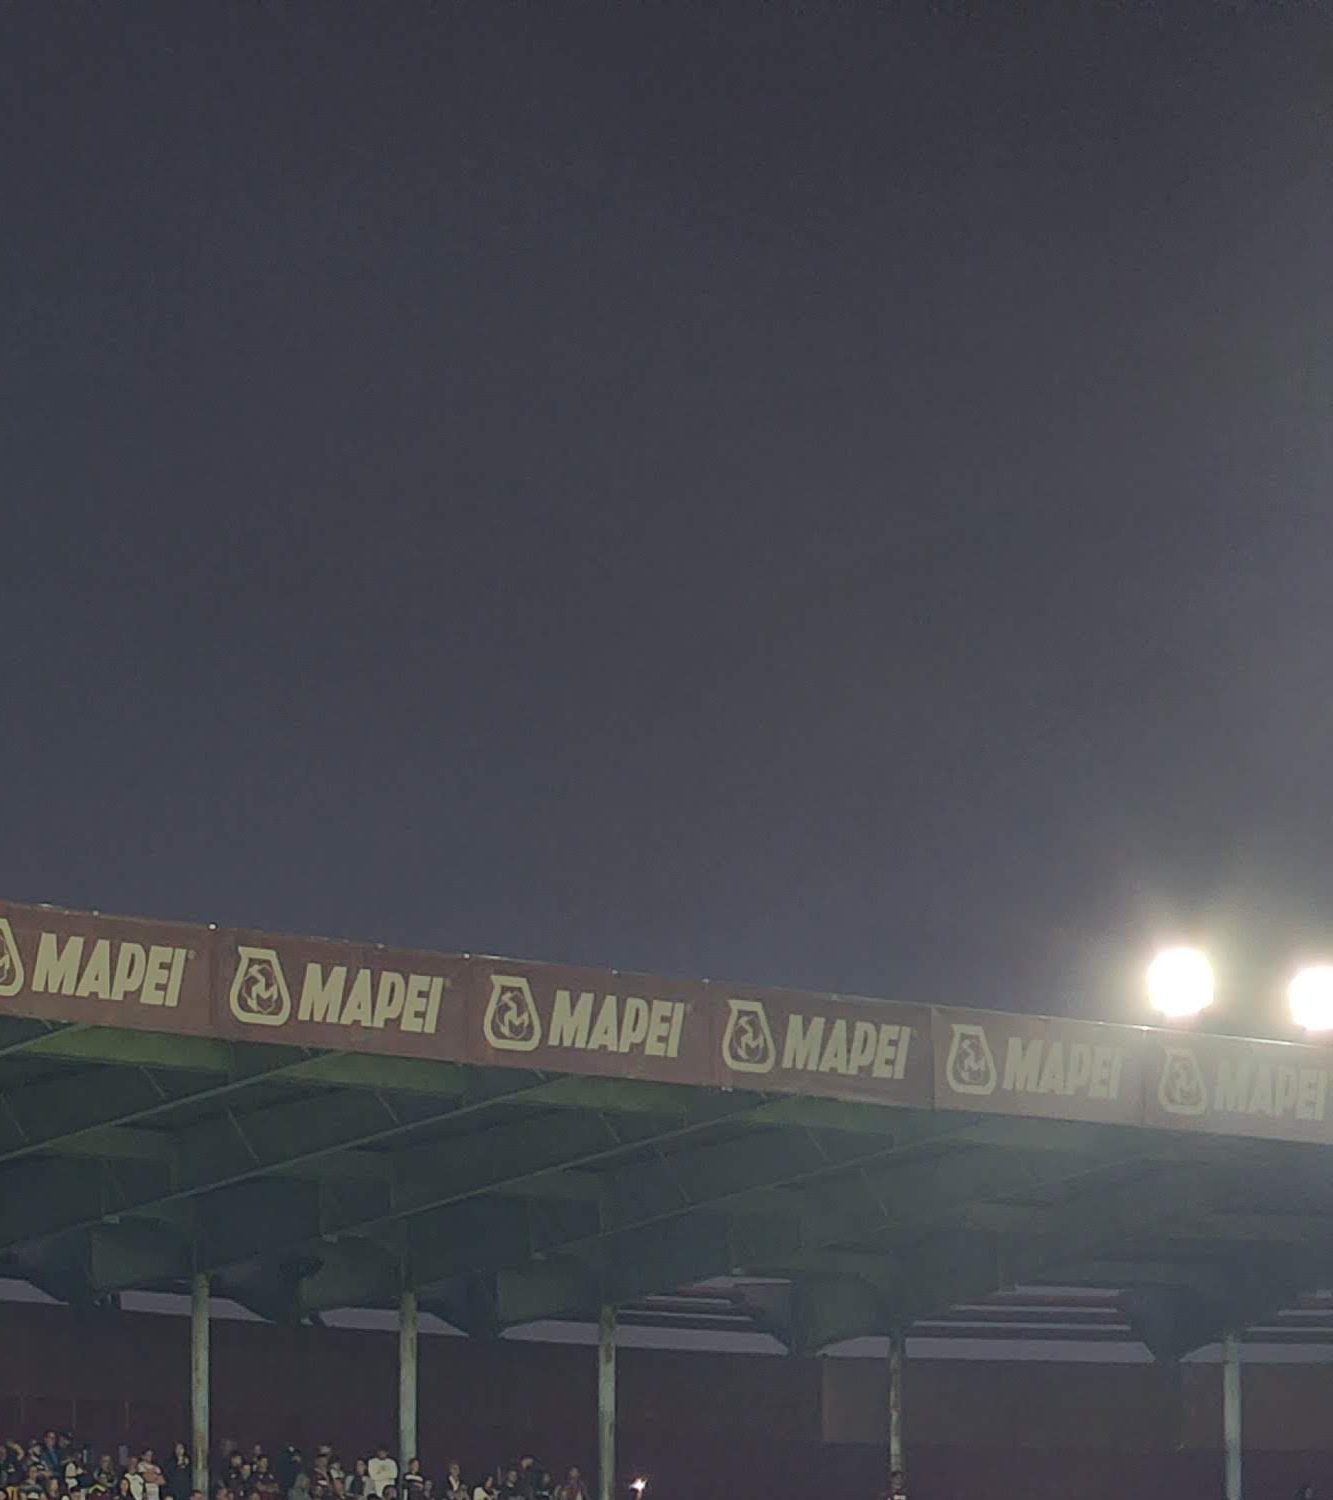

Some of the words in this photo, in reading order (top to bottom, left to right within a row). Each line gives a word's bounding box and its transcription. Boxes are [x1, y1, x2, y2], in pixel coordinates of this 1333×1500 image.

[33, 932, 186, 1006] MAPEI
[298, 963, 443, 1034] MAPEI
[549, 990, 685, 1057] MAPEI
[782, 1014, 912, 1079] MAPEI
[1002, 1037, 1124, 1099] MAPEI
